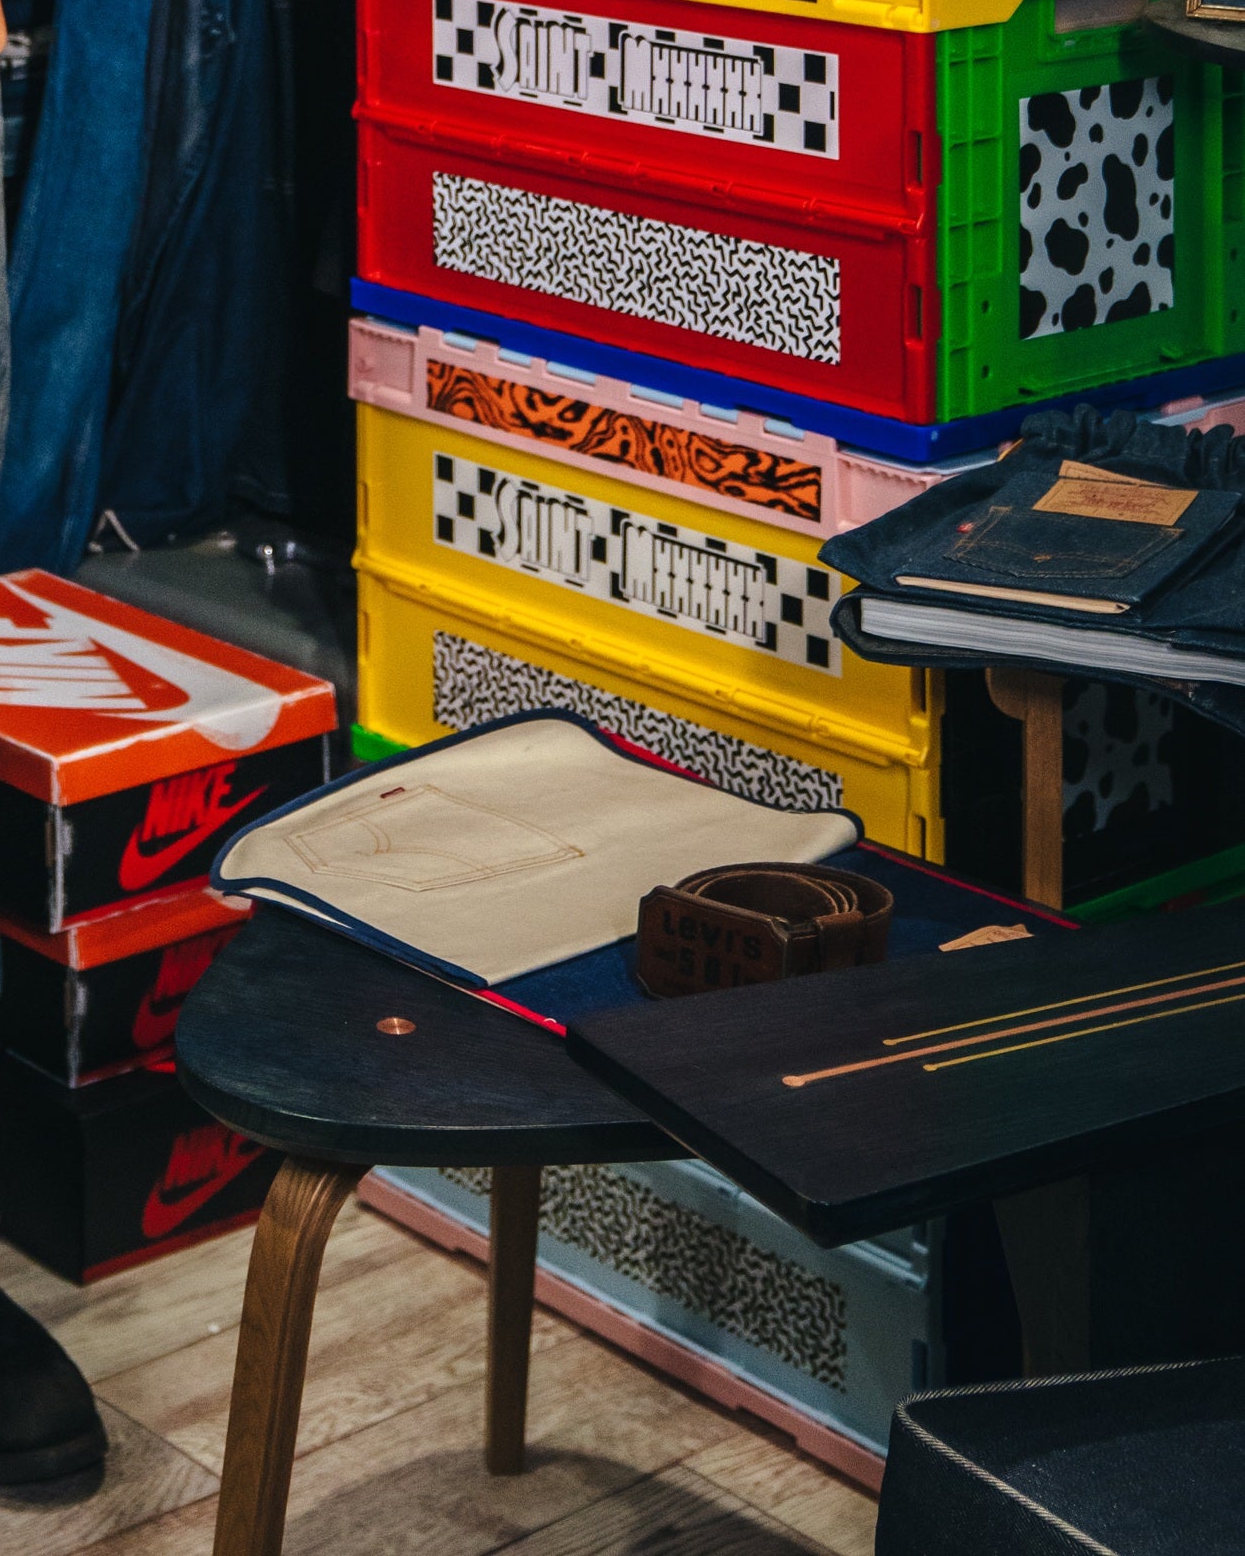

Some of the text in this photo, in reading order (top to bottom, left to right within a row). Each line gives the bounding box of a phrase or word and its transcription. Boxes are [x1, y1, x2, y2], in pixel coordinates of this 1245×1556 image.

[494, 7, 592, 100] SAINT
[493, 478, 594, 581] SAINT
[141, 761, 237, 843] NIKE
